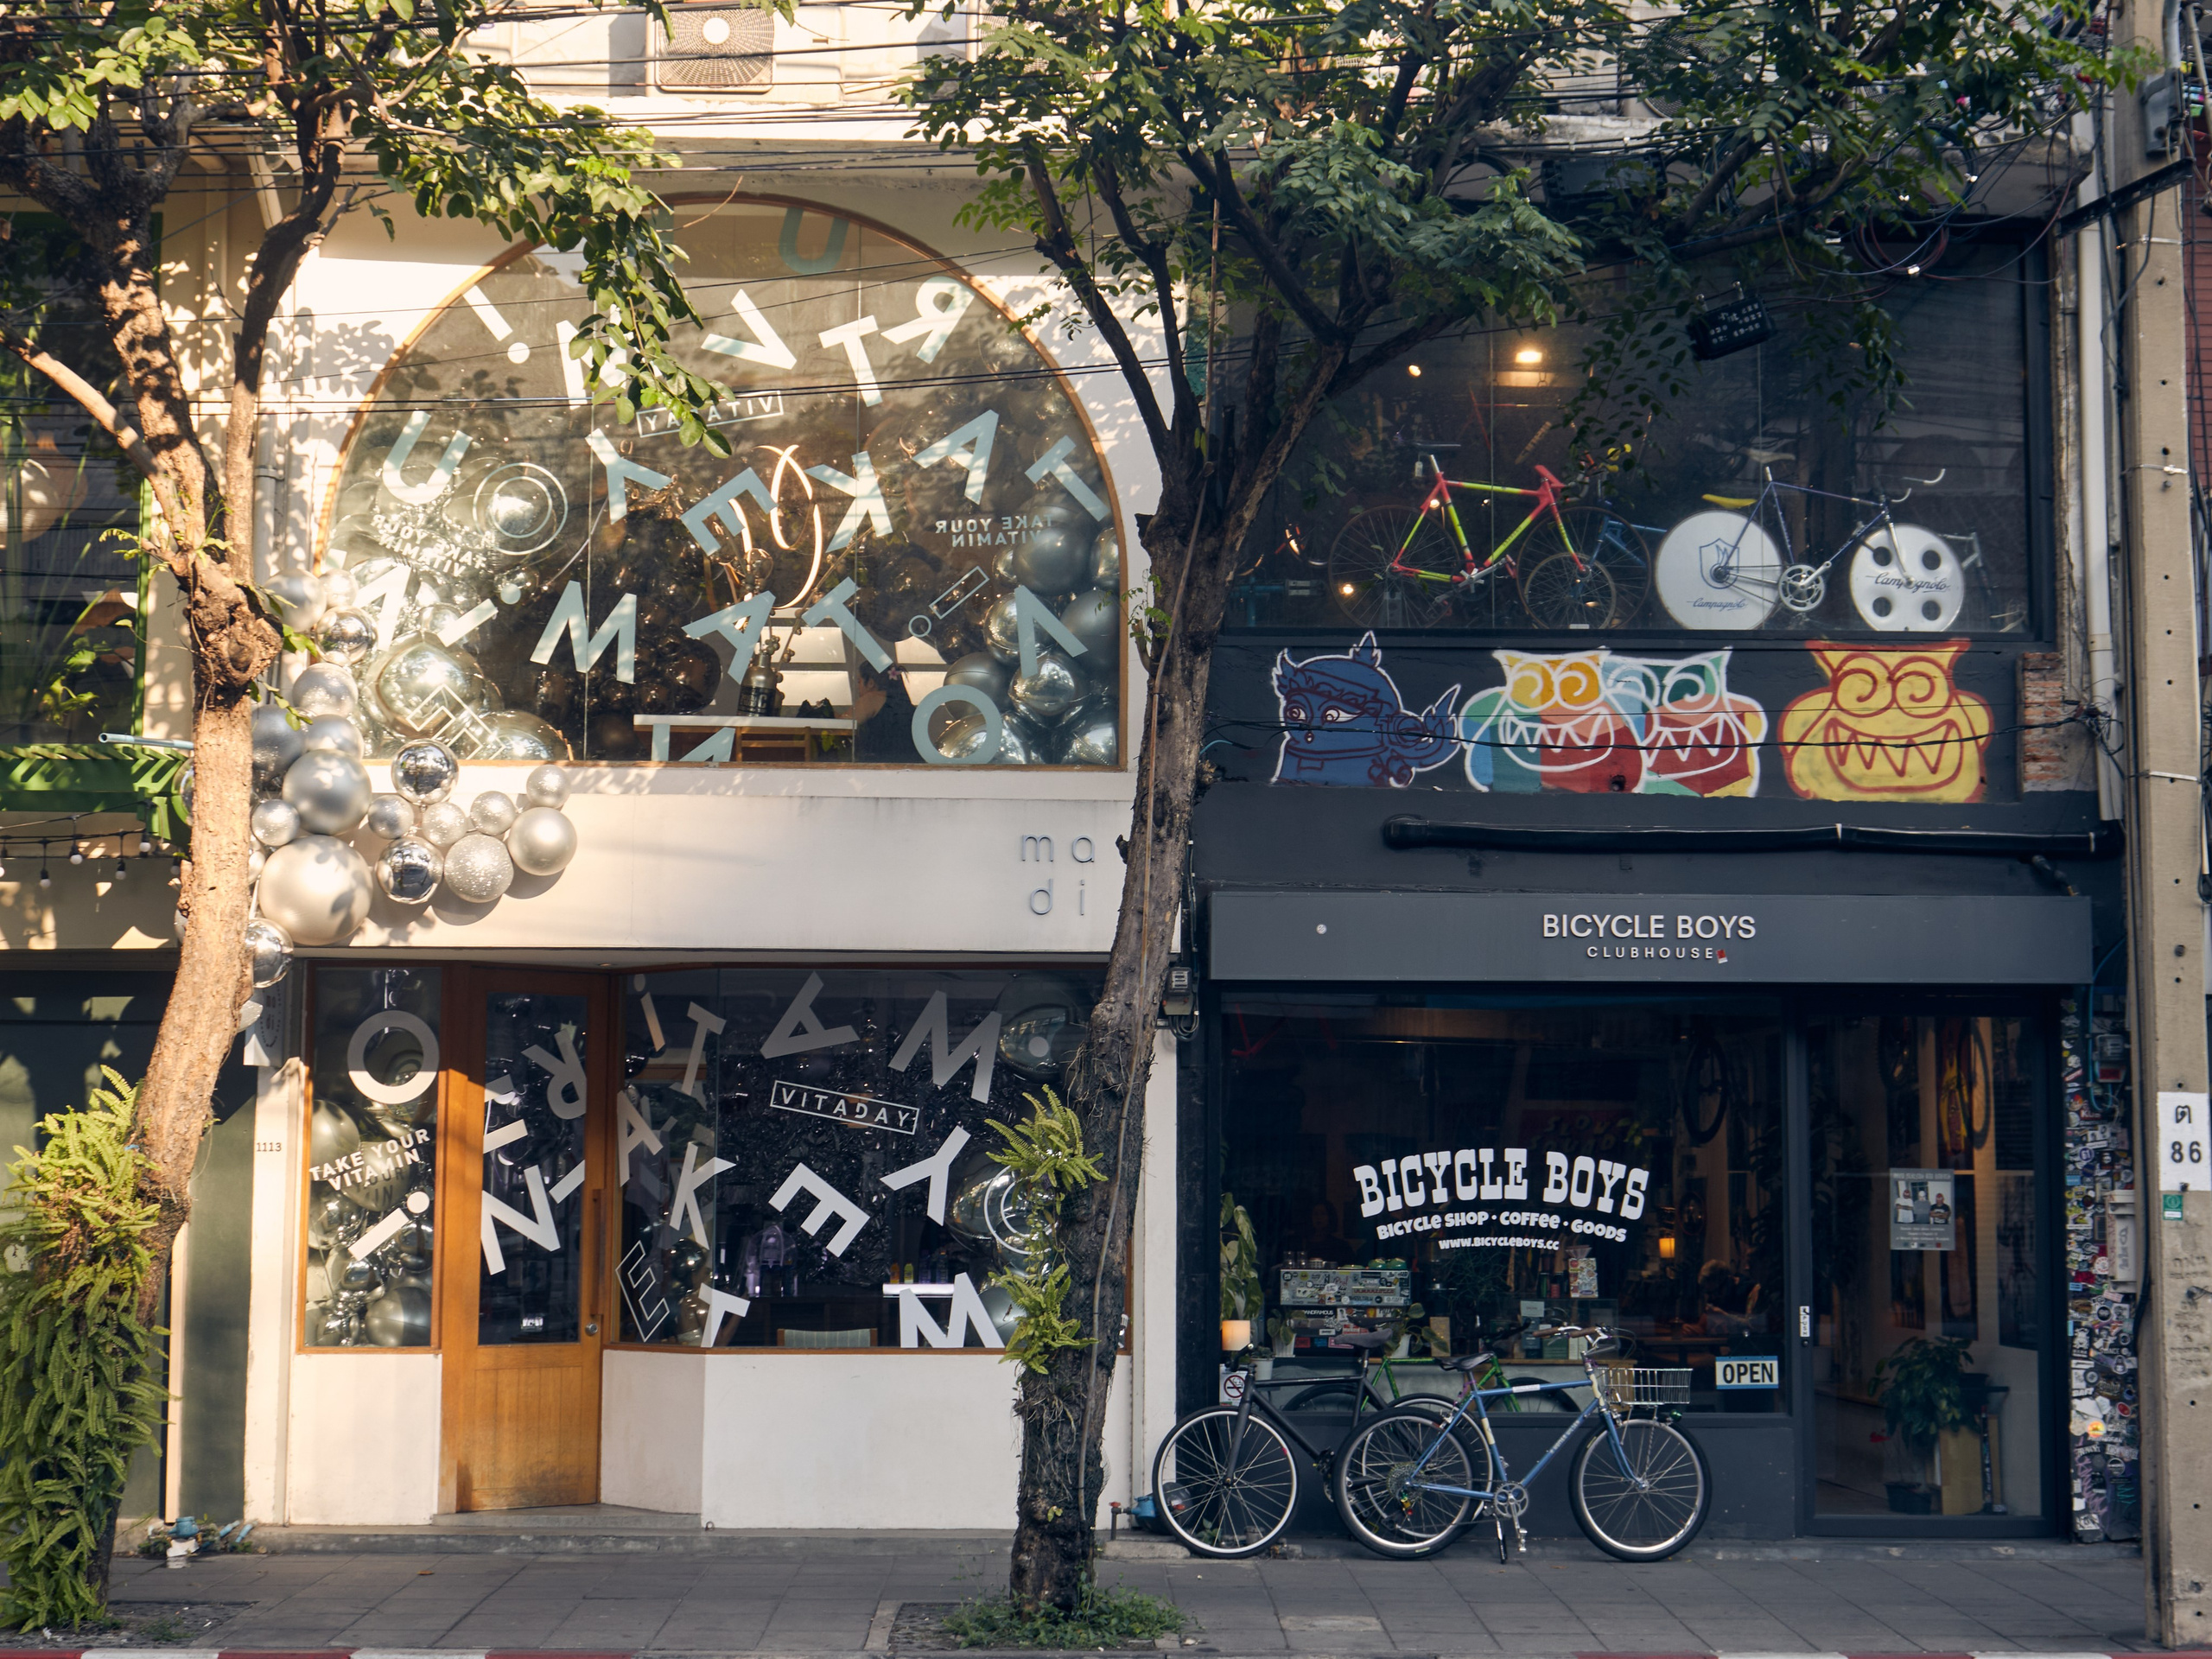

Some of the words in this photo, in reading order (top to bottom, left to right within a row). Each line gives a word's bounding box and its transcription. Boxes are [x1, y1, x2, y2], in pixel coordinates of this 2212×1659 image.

[1873, 572, 1950, 594] Campgnolo
[1542, 914, 1665, 938] BICYCLE
[1676, 915, 1757, 939] BOYS
[1586, 946, 1713, 959] CLUBHOUSE
[781, 1087, 910, 1128] VITADAY
[257, 1142, 282, 1152] 1113
[309, 1151, 365, 1181] TAKE
[371, 1128, 430, 1159] YOUR
[2171, 1141, 2202, 1163] 86
[328, 1148, 421, 1191] VITAMIN
[1353, 1147, 1529, 1217] BICYCLE
[1543, 1150, 1649, 1220] BOYS
[1445, 1211, 1489, 1227] SHOP
[1571, 1218, 1627, 1243] GOODS
[1722, 1362, 1774, 1384] OPEN
